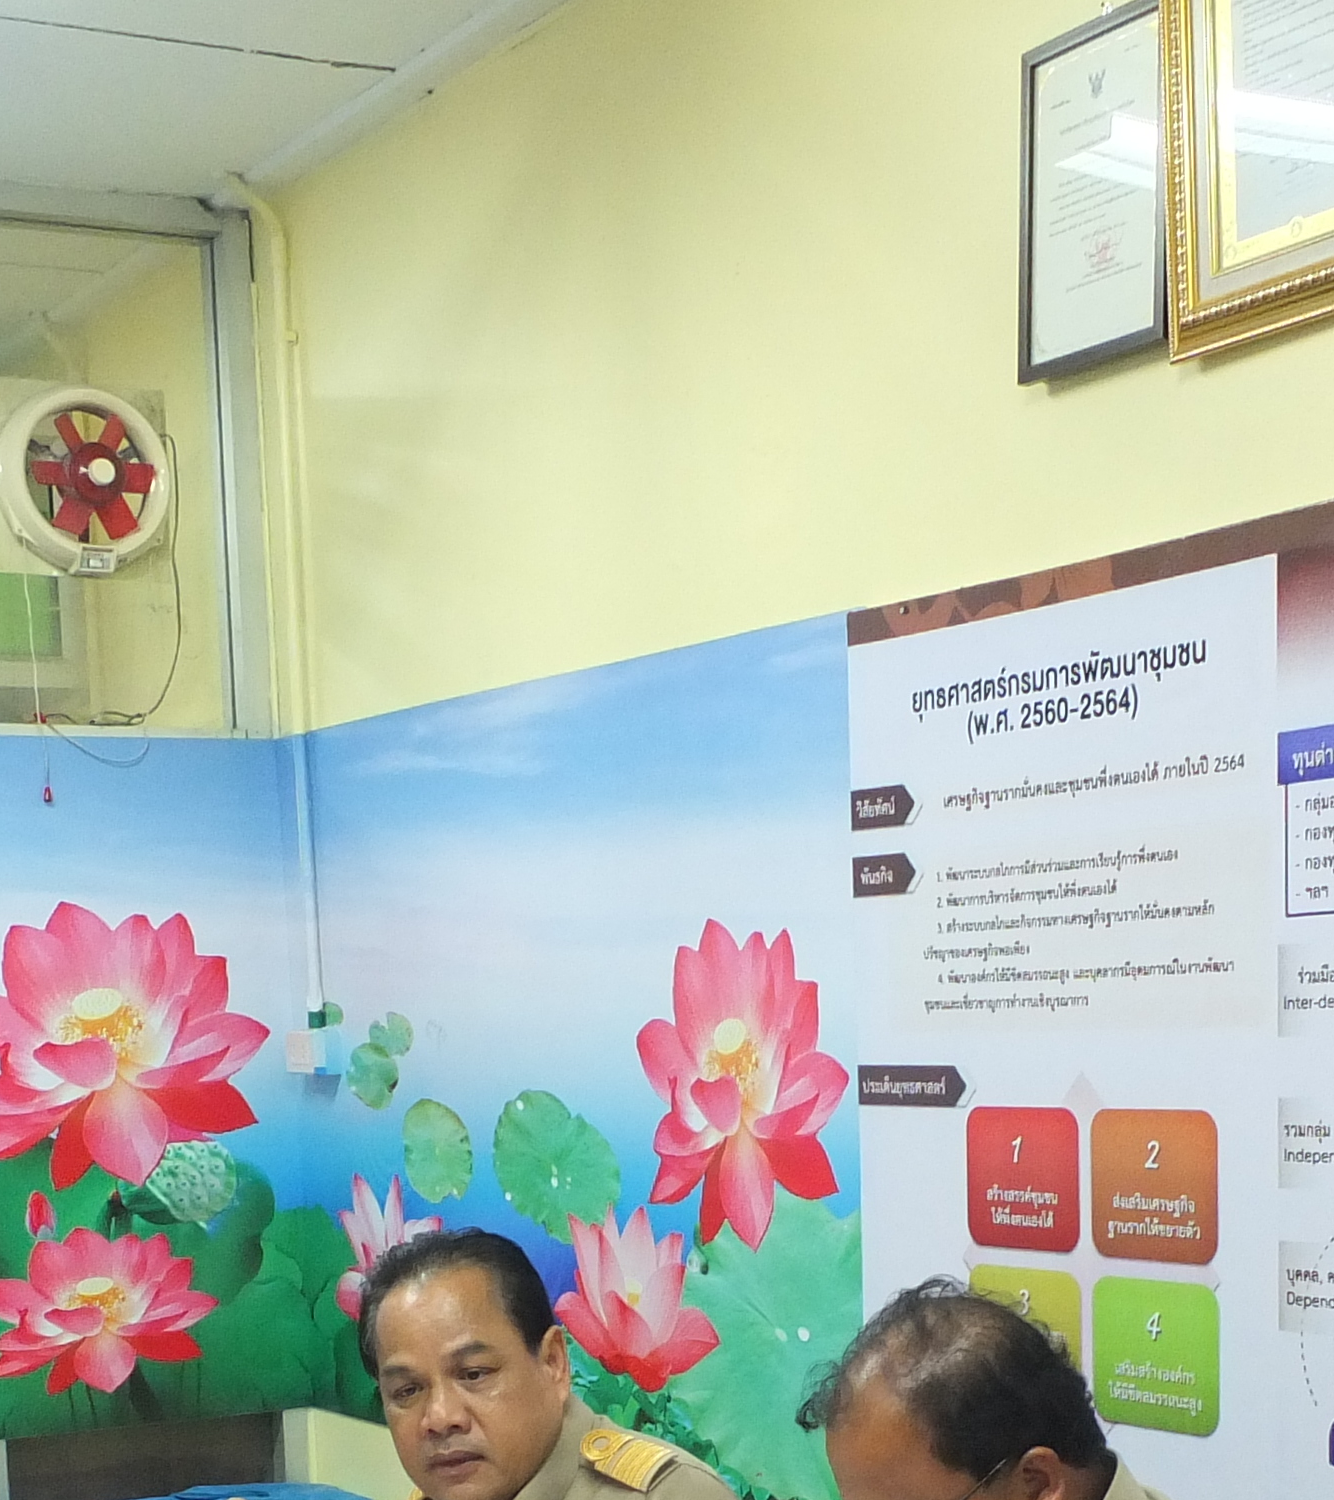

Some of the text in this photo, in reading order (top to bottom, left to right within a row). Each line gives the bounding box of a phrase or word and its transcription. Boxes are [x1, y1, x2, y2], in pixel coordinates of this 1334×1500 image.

[911, 638, 1208, 723] ยุทธศาสตร์กรมการพัฒนาชุมชน
[966, 682, 1140, 744] (พ.ศ. 2560-2564)
[1214, 753, 1246, 773] 2564
[860, 868, 893, 886] พันธกิจ
[1283, 1119, 1331, 1144] รวมกลุ่ม
[1011, 1135, 1023, 1163] 1
[1143, 1140, 1160, 1170] 2
[1145, 1311, 1161, 1341] 4
